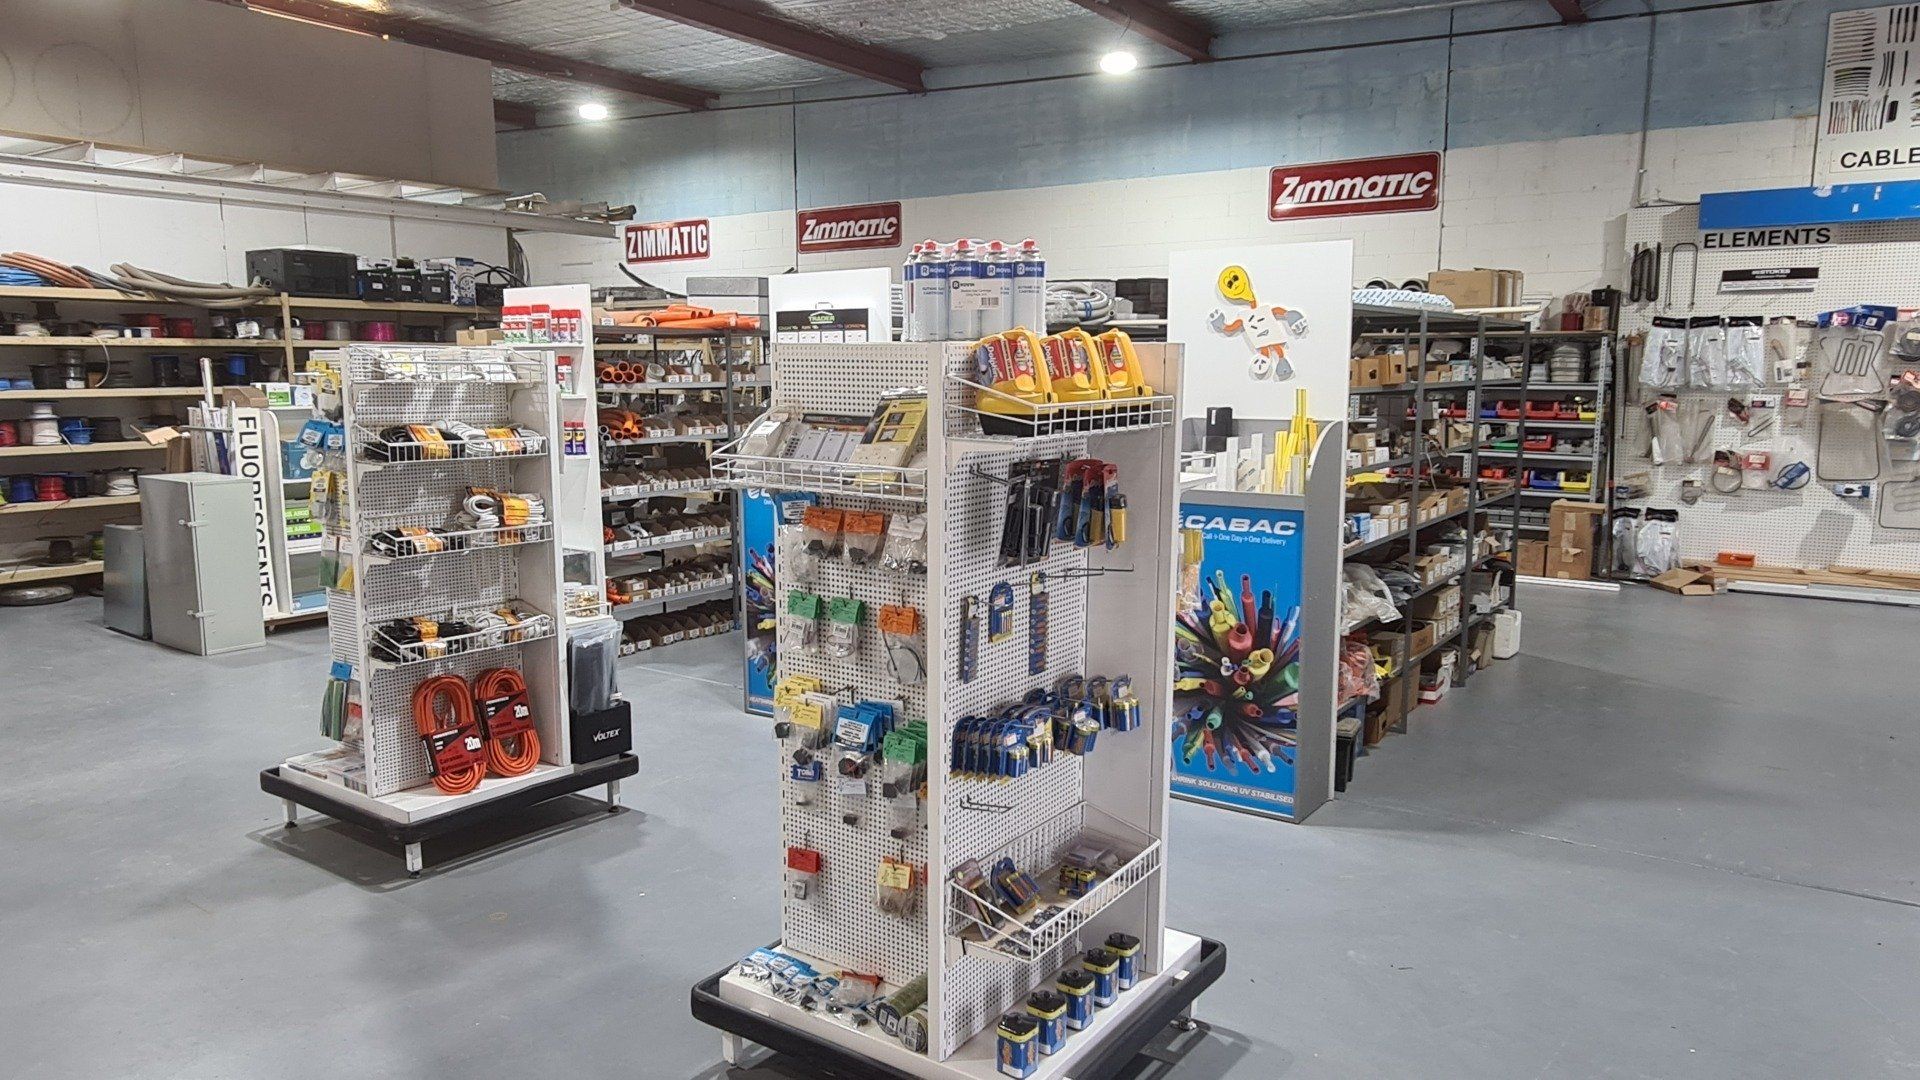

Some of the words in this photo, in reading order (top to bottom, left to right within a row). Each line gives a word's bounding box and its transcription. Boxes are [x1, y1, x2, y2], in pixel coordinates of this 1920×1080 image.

[1839, 147, 1920, 169] CABLE
[627, 223, 708, 259] ZIMMATIC
[1703, 227, 1831, 249] ELEMENTS
[1184, 515, 1297, 536] CABAC
[1218, 534, 1230, 542] One
[1231, 534, 1243, 543] Day
[1248, 535, 1261, 544] One
[1261, 536, 1286, 547] Delivery
[593, 728, 621, 742] VOLTEX
[1198, 779, 1239, 793] SOLUTIONS
[1239, 788, 1251, 796] UV
[1250, 789, 1294, 804] STABILISED
